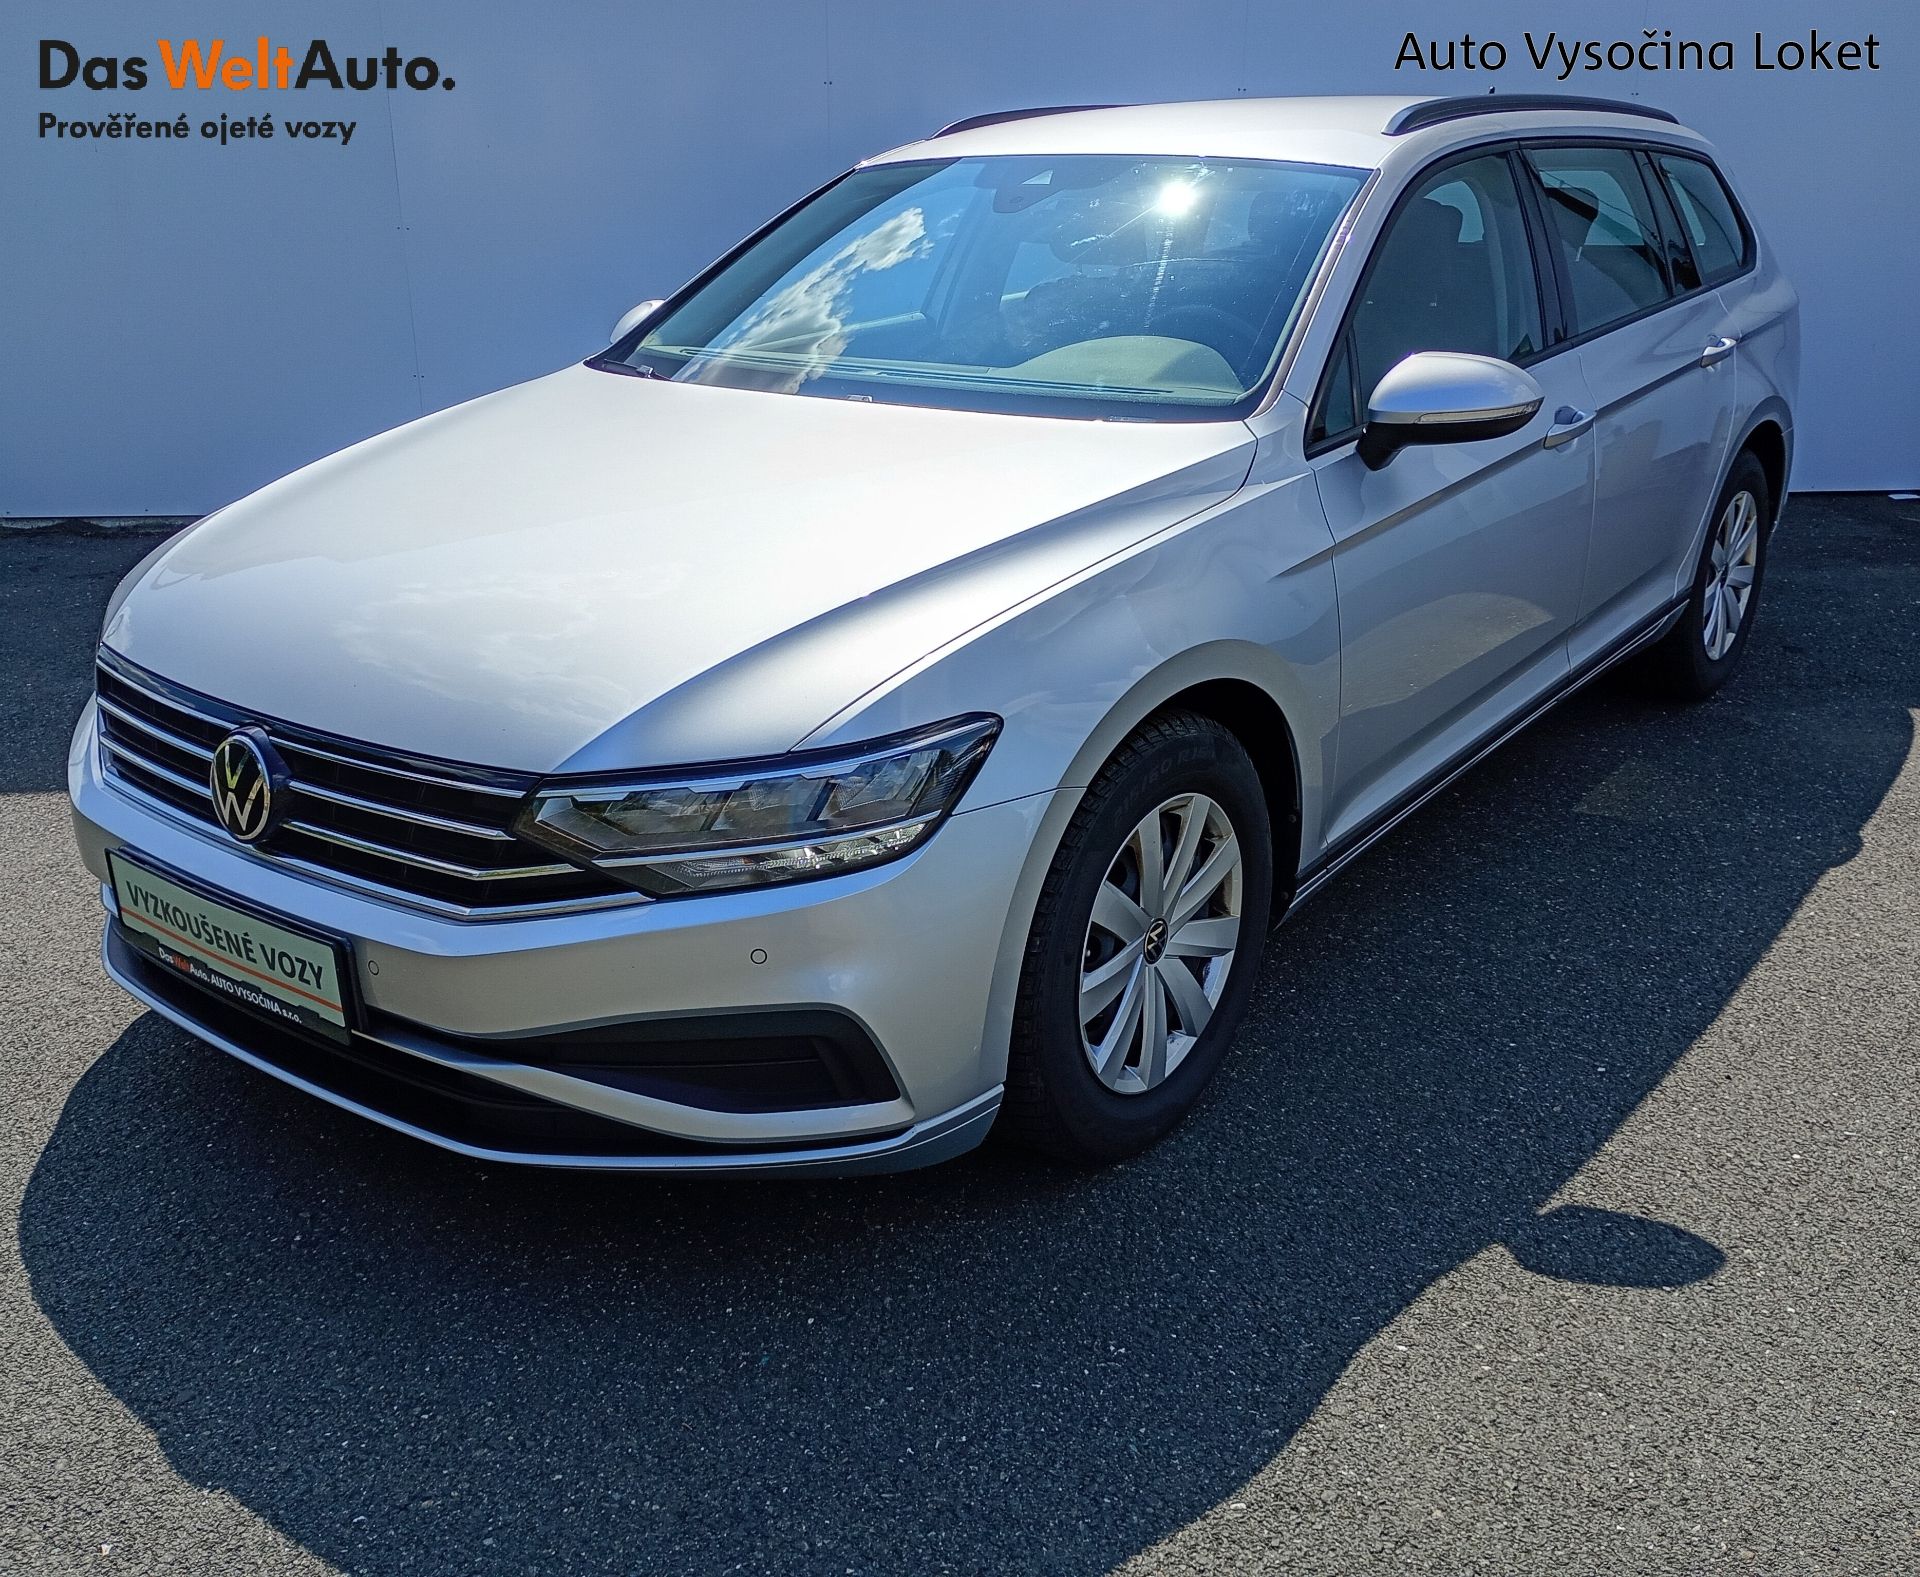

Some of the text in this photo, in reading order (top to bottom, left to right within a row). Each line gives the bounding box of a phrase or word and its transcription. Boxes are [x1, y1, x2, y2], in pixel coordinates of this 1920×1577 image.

[126, 880, 323, 990] VYZKOUŠENÉ VOZY
[211, 974, 234, 993] AUTO
[234, 984, 282, 1015] VYSOČINA
